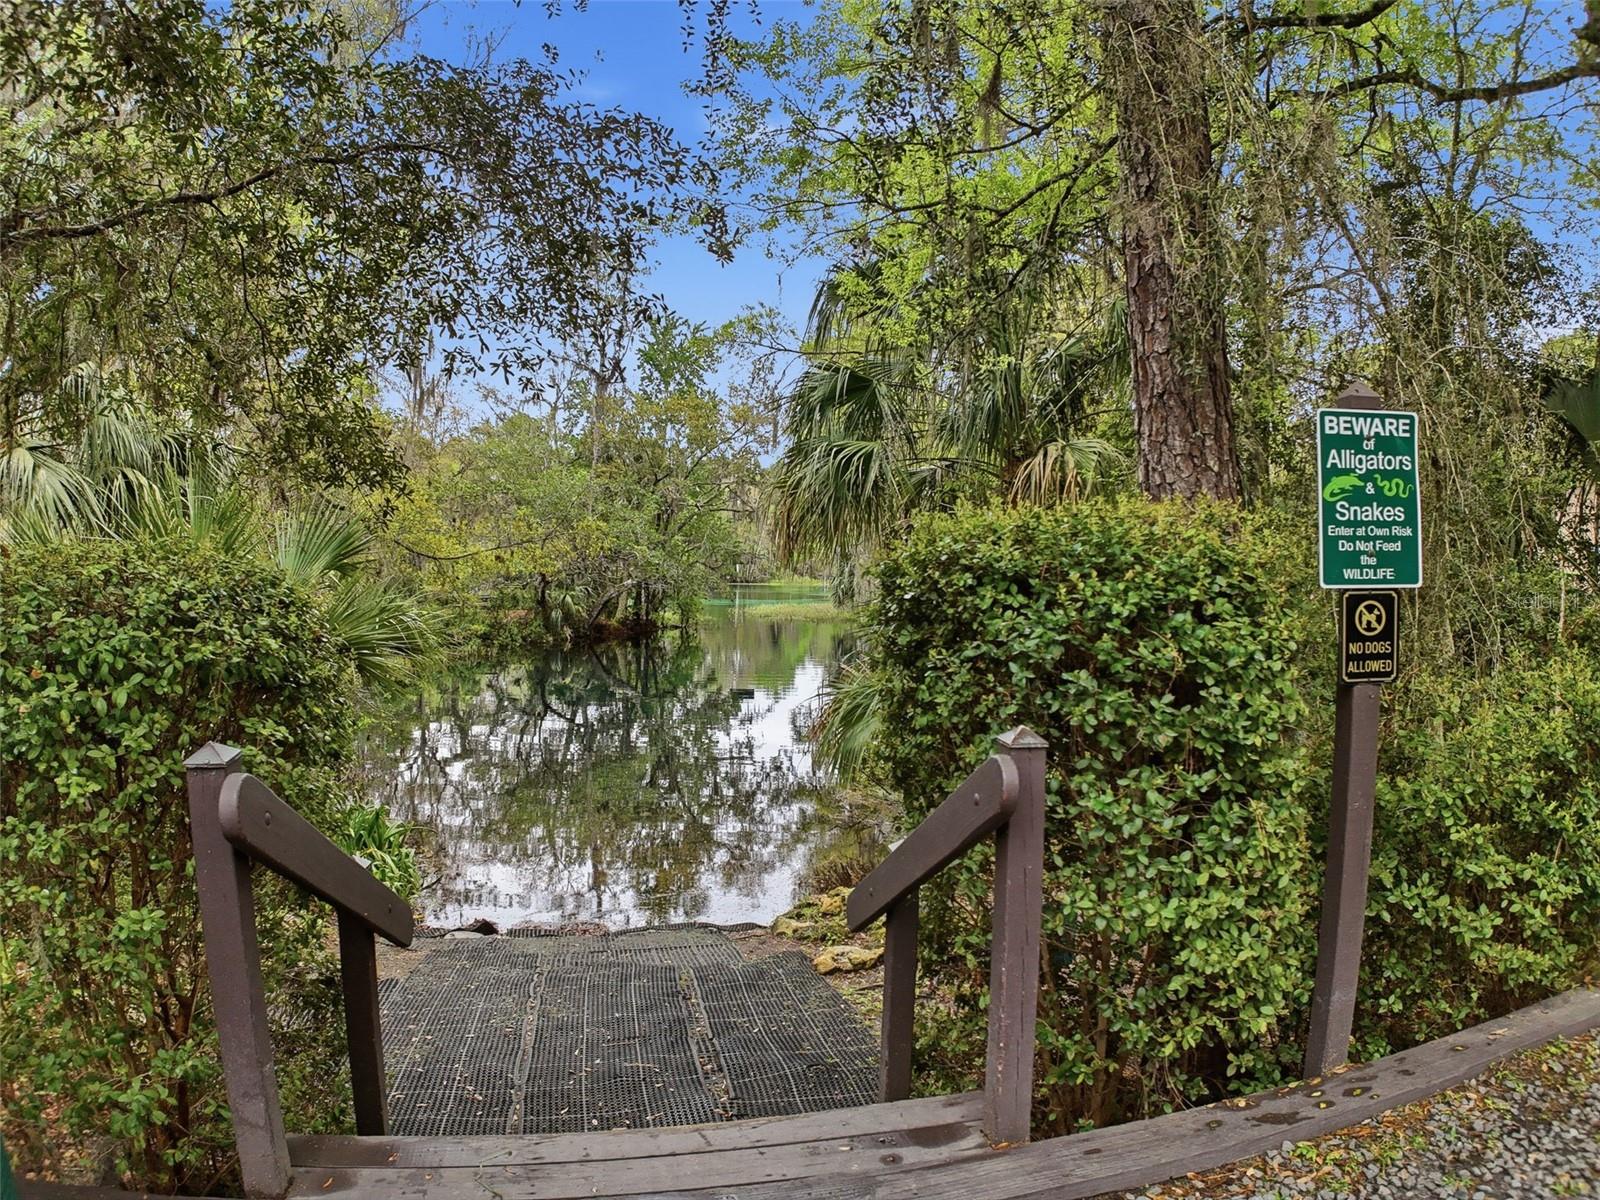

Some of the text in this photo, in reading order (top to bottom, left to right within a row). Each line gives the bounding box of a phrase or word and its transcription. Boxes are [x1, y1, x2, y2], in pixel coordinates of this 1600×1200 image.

[1324, 415, 1411, 438] BEWARE
[1362, 438, 1376, 451] of
[1326, 449, 1412, 474] Alligators
[1365, 482, 1375, 495] &
[1335, 501, 1405, 522] Snakes
[1327, 525, 1413, 537] Enter at Own Risk
[1338, 540, 1402, 551] Do Not Feed
[1360, 554, 1377, 565] the
[1343, 568, 1395, 579] WILDLIFE
[1349, 641, 1392, 654] NO DOGS
[1347, 660, 1392, 673] ALLOWED
